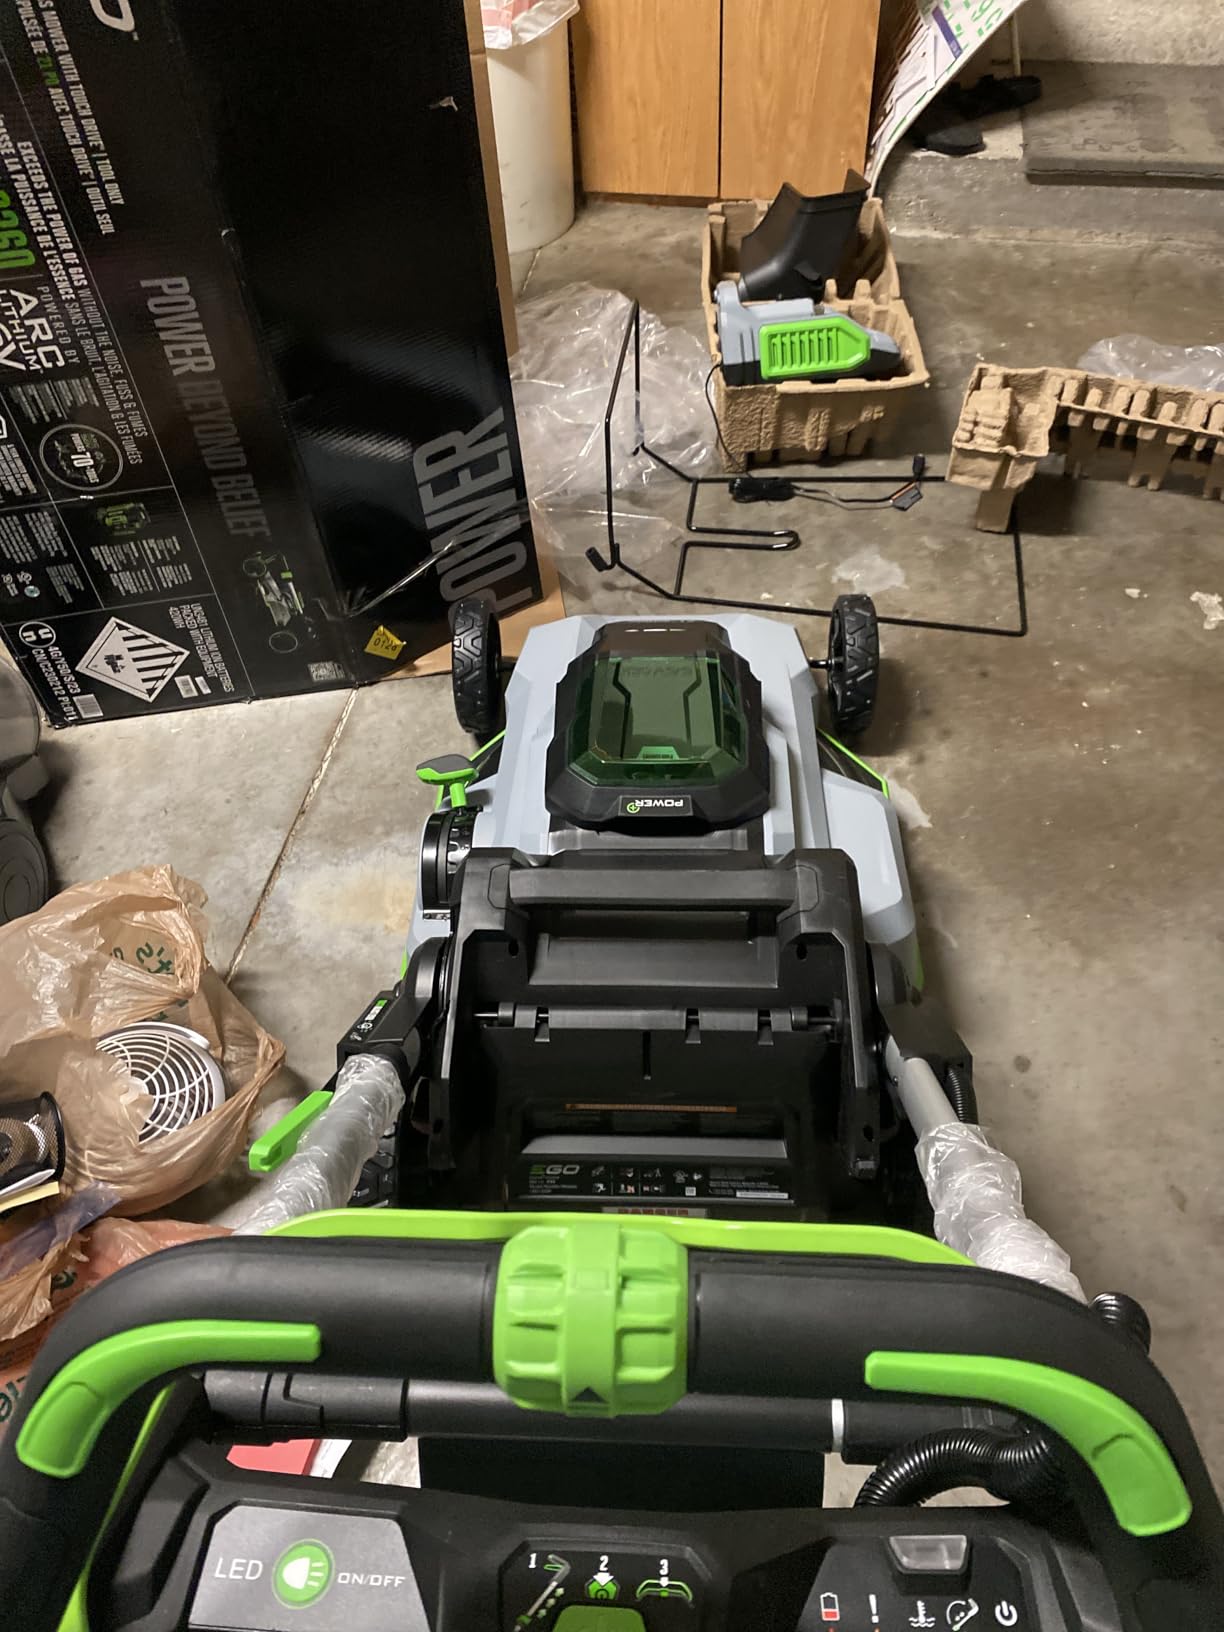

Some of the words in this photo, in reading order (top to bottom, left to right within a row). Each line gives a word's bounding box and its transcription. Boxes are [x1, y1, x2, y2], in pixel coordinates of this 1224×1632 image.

[42, 11, 69, 52] MOWER
[58, 54, 80, 81] WITH
[70, 84, 92, 116] TOUCH
[31, 41, 48, 54] DE
[48, 88, 70, 112] AVEC
[59, 114, 82, 145] TOUCH
[86, 188, 106, 212] OUTIL
[96, 214, 114, 234] SEUL
[4, 158, 22, 171] LA
[17, 142, 48, 189] EXCEEDS
[96, 159, 115, 181] TOOL
[11, 174, 48, 232] PUISSANCE
[38, 192, 58, 211] THE
[105, 183, 124, 204] ONLY
[37, 235, 54, 248] DE
[46, 214, 73, 250] POWER
[63, 252, 79, 264] OF
[44, 250, 75, 300] L'ESSENCE
[69, 268, 87, 286] GAS
[65, 302, 86, 325] SANS
[78, 288, 104, 327] WITHOUT
[10, 289, 64, 368] ARC
[37, 286, 71, 343] POWERED
[64, 350, 80, 362] BY
[76, 327, 90, 336] LE
[140, 276, 215, 376] POWER
[96, 331, 112, 346] THE
[92, 367, 121, 411] L'AGITATION
[114, 380, 133, 400] FUSS
[114, 421, 130, 434] LES
[127, 411, 148, 436] FUMES
[178, 379, 247, 477] BEYOND
[121, 434, 142, 464] FUMÉES
[212, 473, 271, 537] BELIEF
[180, 605, 197, 628] PACKED
[190, 630, 204, 644] WITH
[200, 628, 218, 651] LITHIUM
[196, 645, 218, 677] EQUIPMENT
[210, 652, 222, 662] ION
[214, 662, 234, 692] BATTERIES
[530, 1164, 580, 1175] EGO
[214, 1557, 263, 1580] LED
[337, 1572, 406, 1588] ON/OFF
[528, 1553, 537, 1568] 1
[600, 1555, 609, 1571] 2
[659, 1559, 669, 1576] 3
